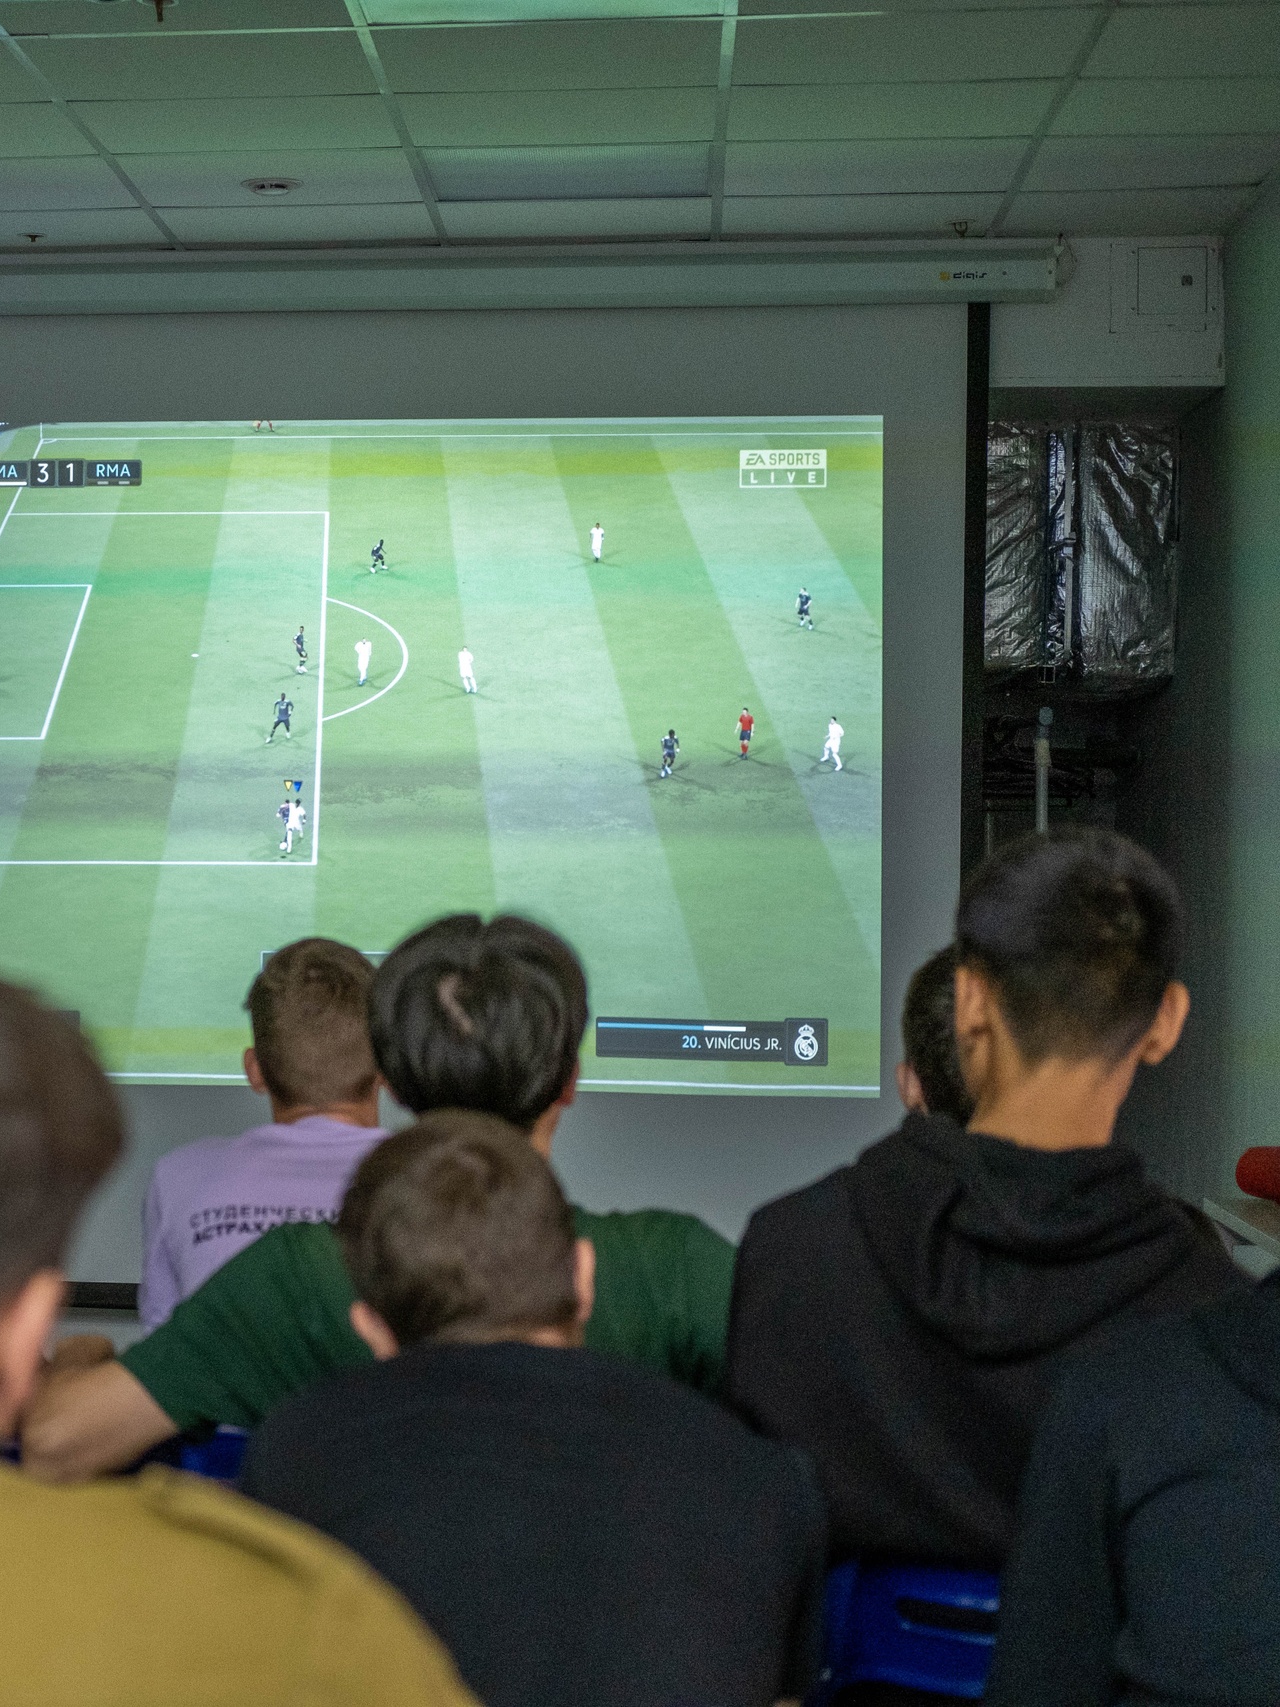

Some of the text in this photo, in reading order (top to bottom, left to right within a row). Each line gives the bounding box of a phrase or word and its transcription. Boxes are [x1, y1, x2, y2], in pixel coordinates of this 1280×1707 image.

[745, 452, 821, 466] EA SPORTS
[37, 463, 49, 483] 3
[65, 462, 75, 482] 1
[95, 463, 131, 478] RMA
[750, 471, 816, 484] LIVE
[682, 1034, 782, 1051] 20. VINÍCIUS JR.
